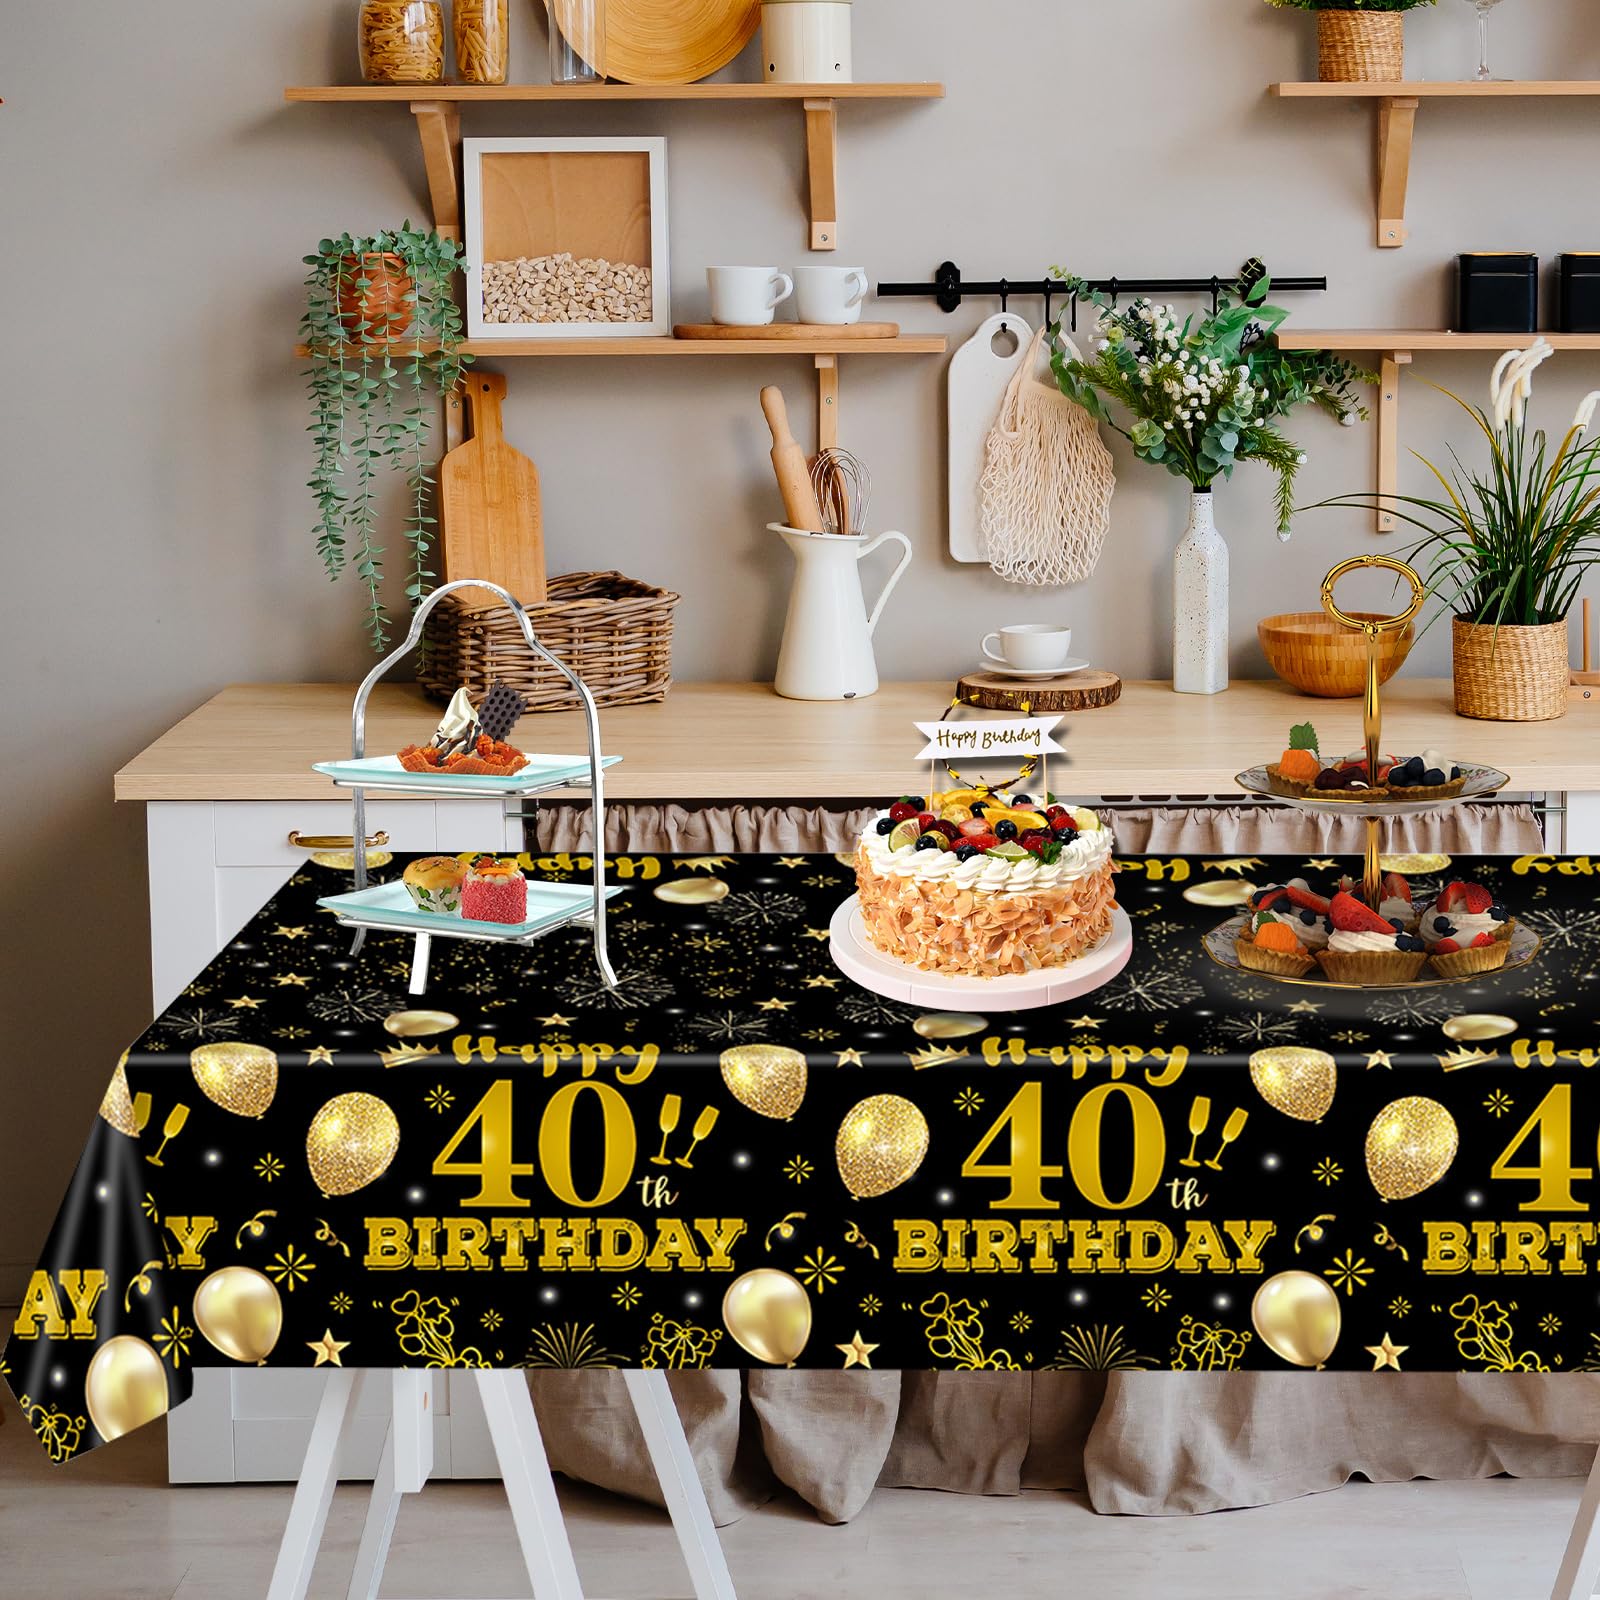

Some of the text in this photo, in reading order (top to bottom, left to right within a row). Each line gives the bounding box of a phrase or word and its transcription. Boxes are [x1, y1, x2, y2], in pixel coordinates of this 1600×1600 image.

[936, 727, 1041, 749] Happy Birthday
[452, 1034, 660, 1085] Happy
[981, 1036, 1190, 1087] Happy
[1511, 1039, 1600, 1068] Ha
[1490, 1083, 1600, 1211] 4
[162, 1216, 218, 1270] Y
[364, 1216, 748, 1272] BIRTHDAY
[892, 1219, 1277, 1274] BIRTHDAY
[1422, 1221, 1600, 1275] BIRT
[14, 1269, 109, 1340] AY
